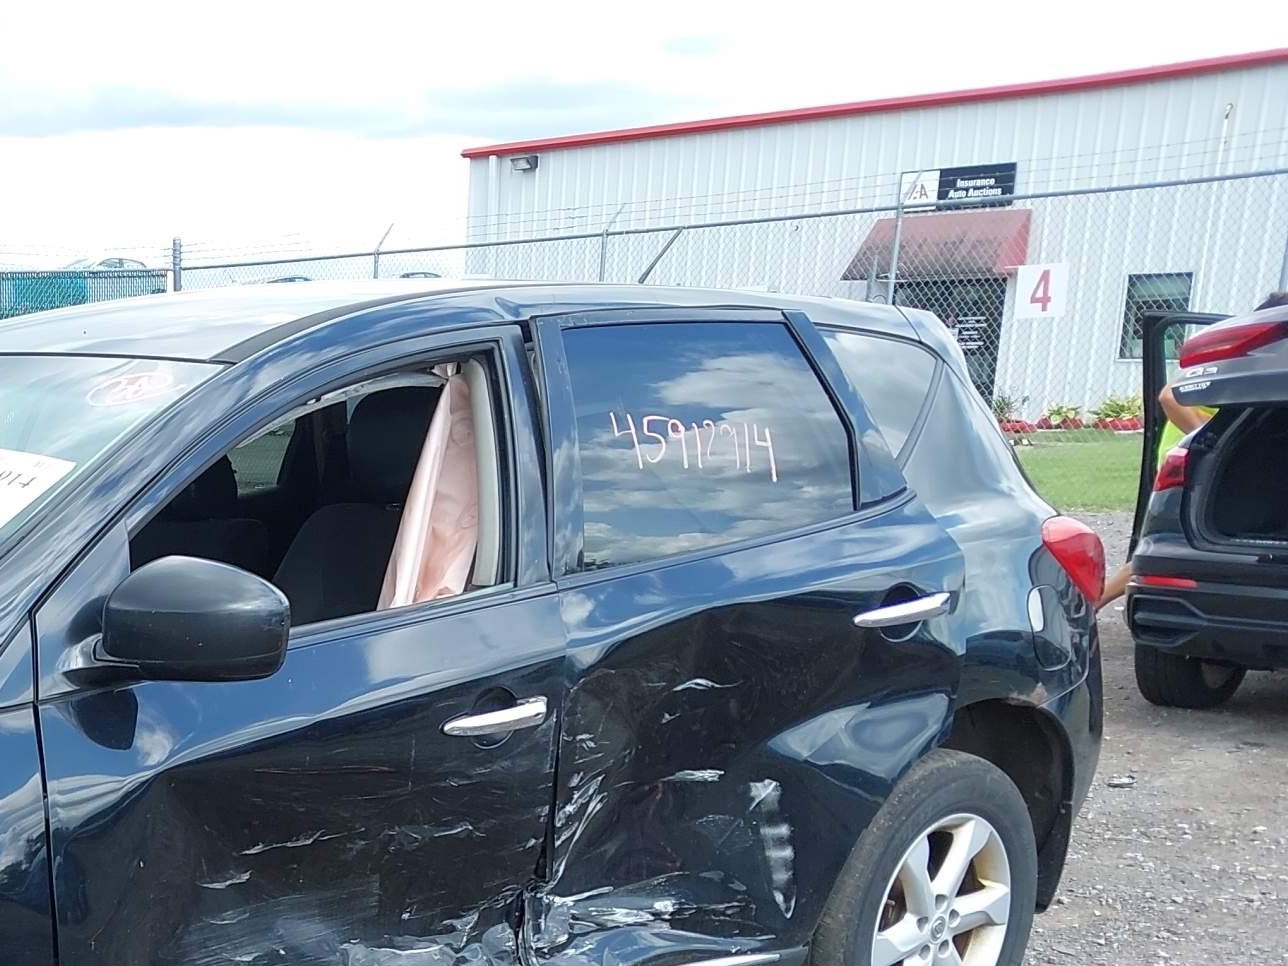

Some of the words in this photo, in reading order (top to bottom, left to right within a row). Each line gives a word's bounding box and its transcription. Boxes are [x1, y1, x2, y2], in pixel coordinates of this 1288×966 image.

[948, 189, 967, 198] Auto
[967, 187, 1002, 197] Auctions
[956, 178, 996, 188] Insurance
[1030, 269, 1052, 312] 4
[609, 411, 778, 483] 45912914
